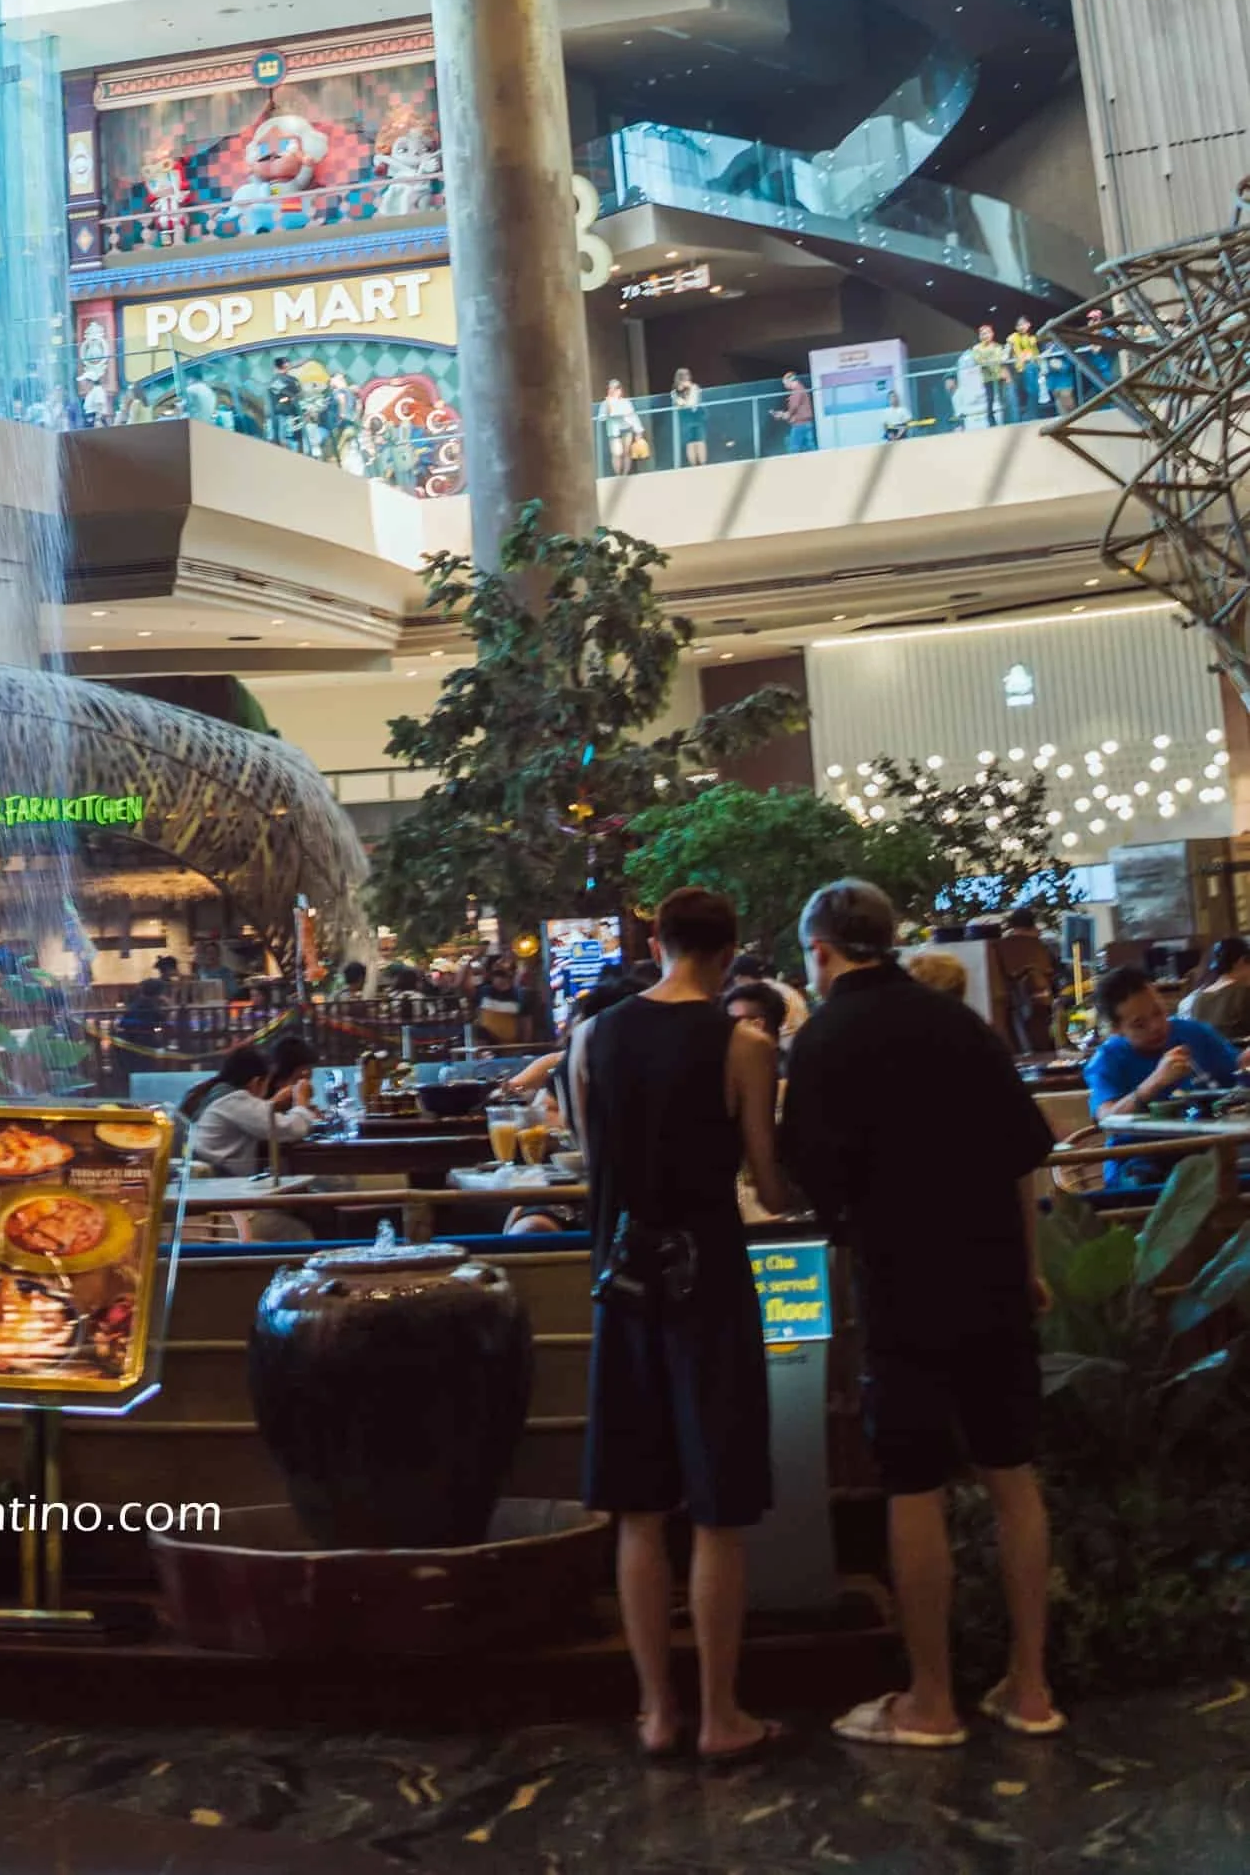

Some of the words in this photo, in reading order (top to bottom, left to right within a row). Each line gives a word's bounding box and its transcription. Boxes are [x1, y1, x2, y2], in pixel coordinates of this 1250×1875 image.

[145, 296, 253, 348] POP
[272, 272, 431, 334] MART
[5, 794, 60, 826] FARM
[61, 794, 143, 825] KITCHEN
[765, 1298, 822, 1322] floor
